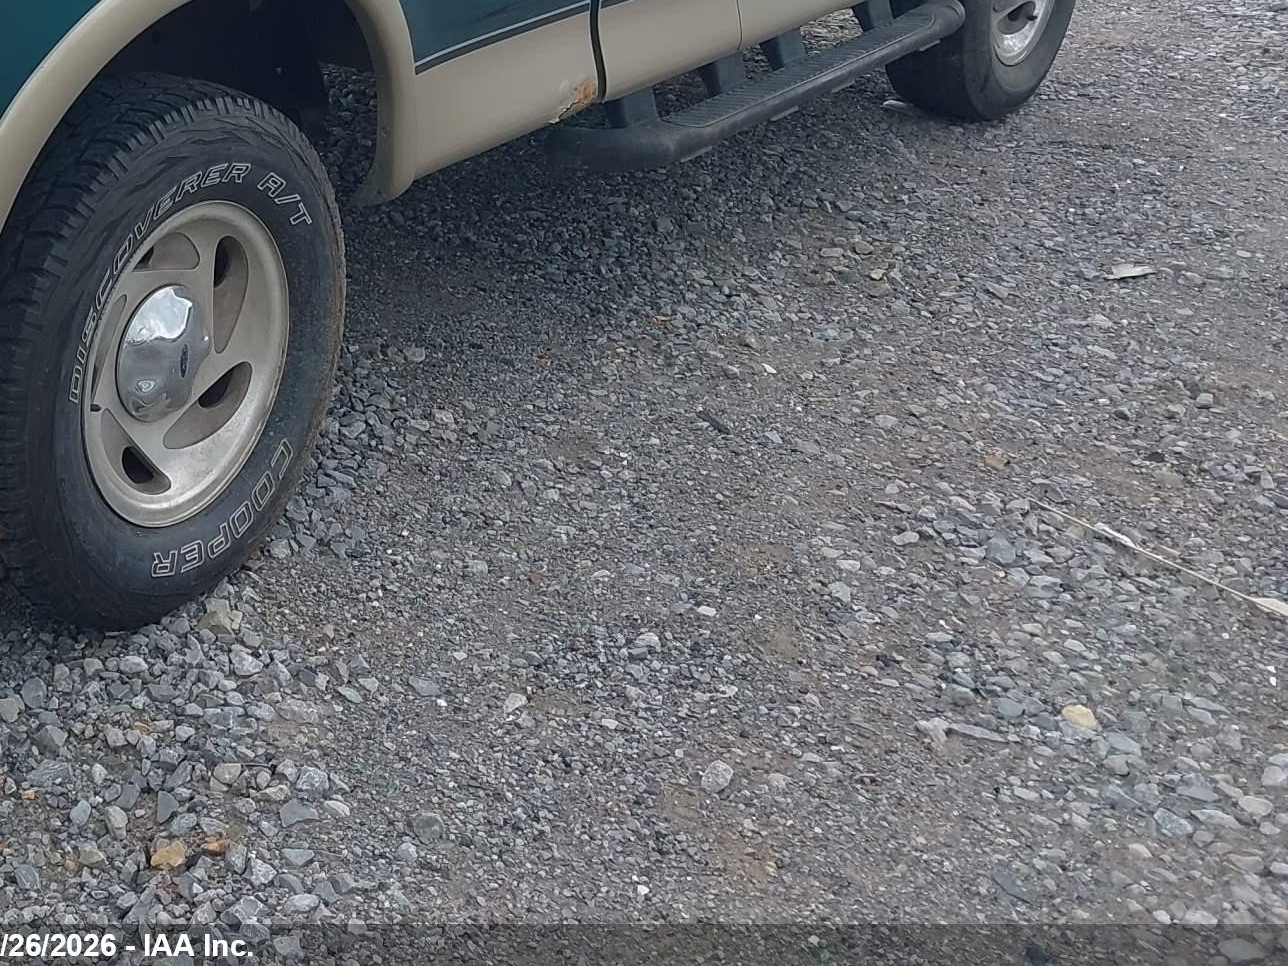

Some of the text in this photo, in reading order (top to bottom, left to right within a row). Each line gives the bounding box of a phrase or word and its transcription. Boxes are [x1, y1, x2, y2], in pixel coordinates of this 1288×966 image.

[68, 162, 314, 405] DISCOVERER A/T
[151, 438, 294, 579] COOPER
